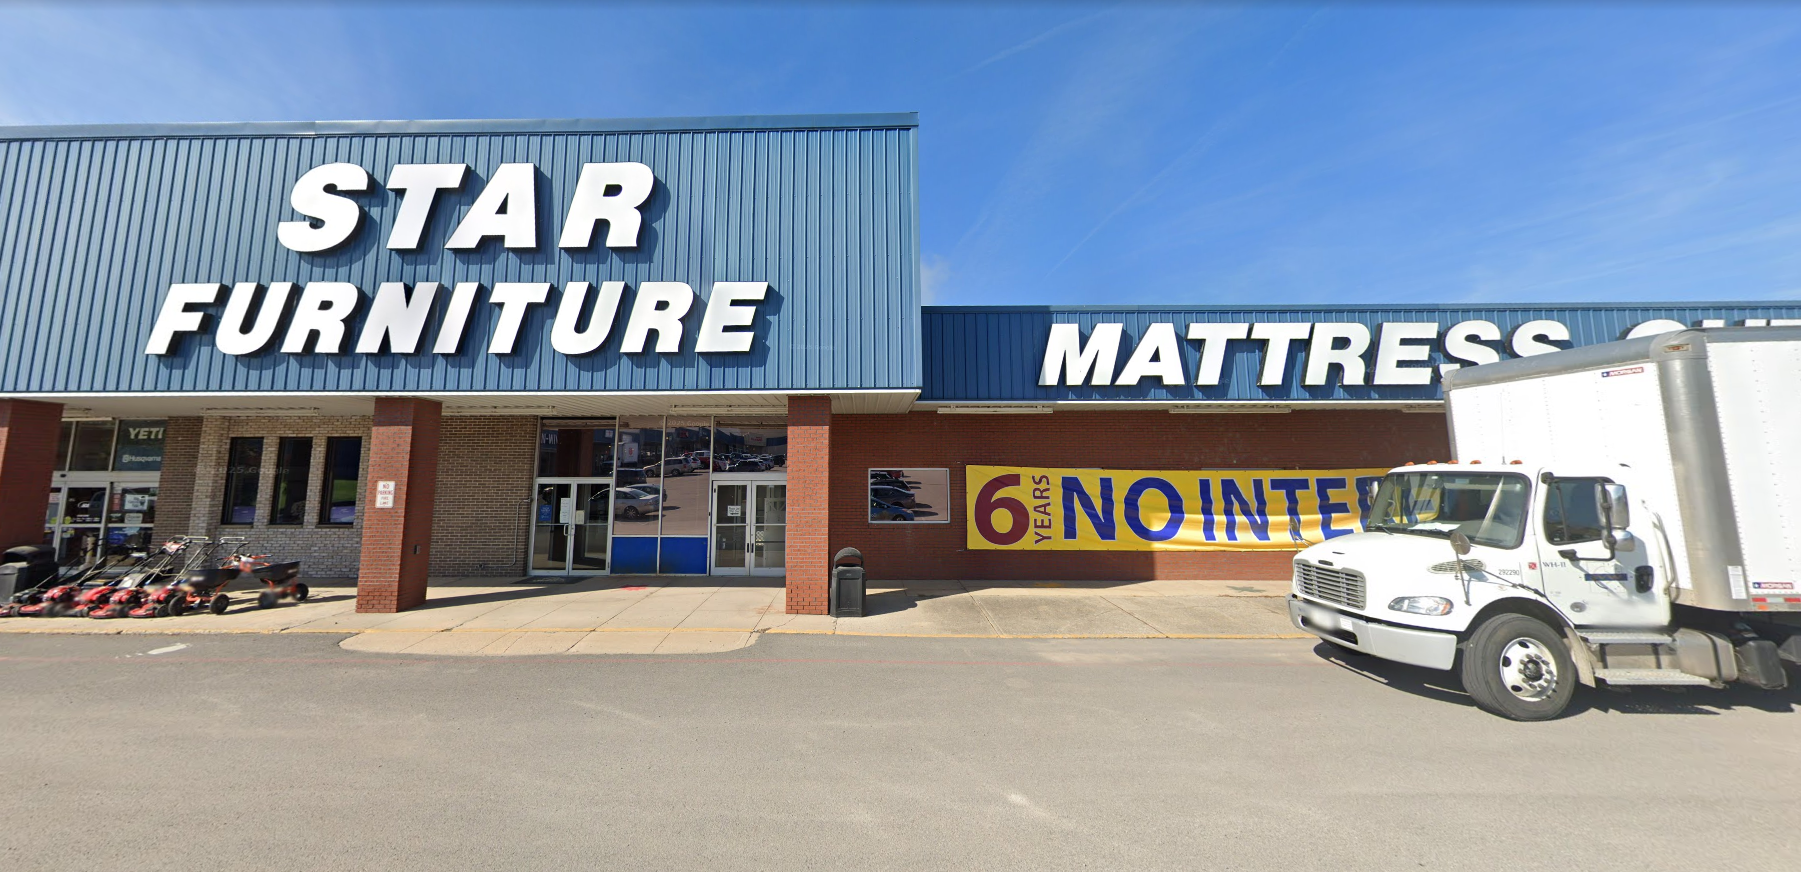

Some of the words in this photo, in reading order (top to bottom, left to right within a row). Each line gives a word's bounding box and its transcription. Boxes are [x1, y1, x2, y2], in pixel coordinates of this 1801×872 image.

[277, 161, 656, 253] STAR
[144, 280, 770, 356] FURNITURE
[128, 427, 165, 440] YETI
[974, 473, 1031, 546] 6
[1034, 473, 1053, 545] YEARS
[1060, 475, 1187, 543] NO
[1498, 568, 1520, 576] 292290
